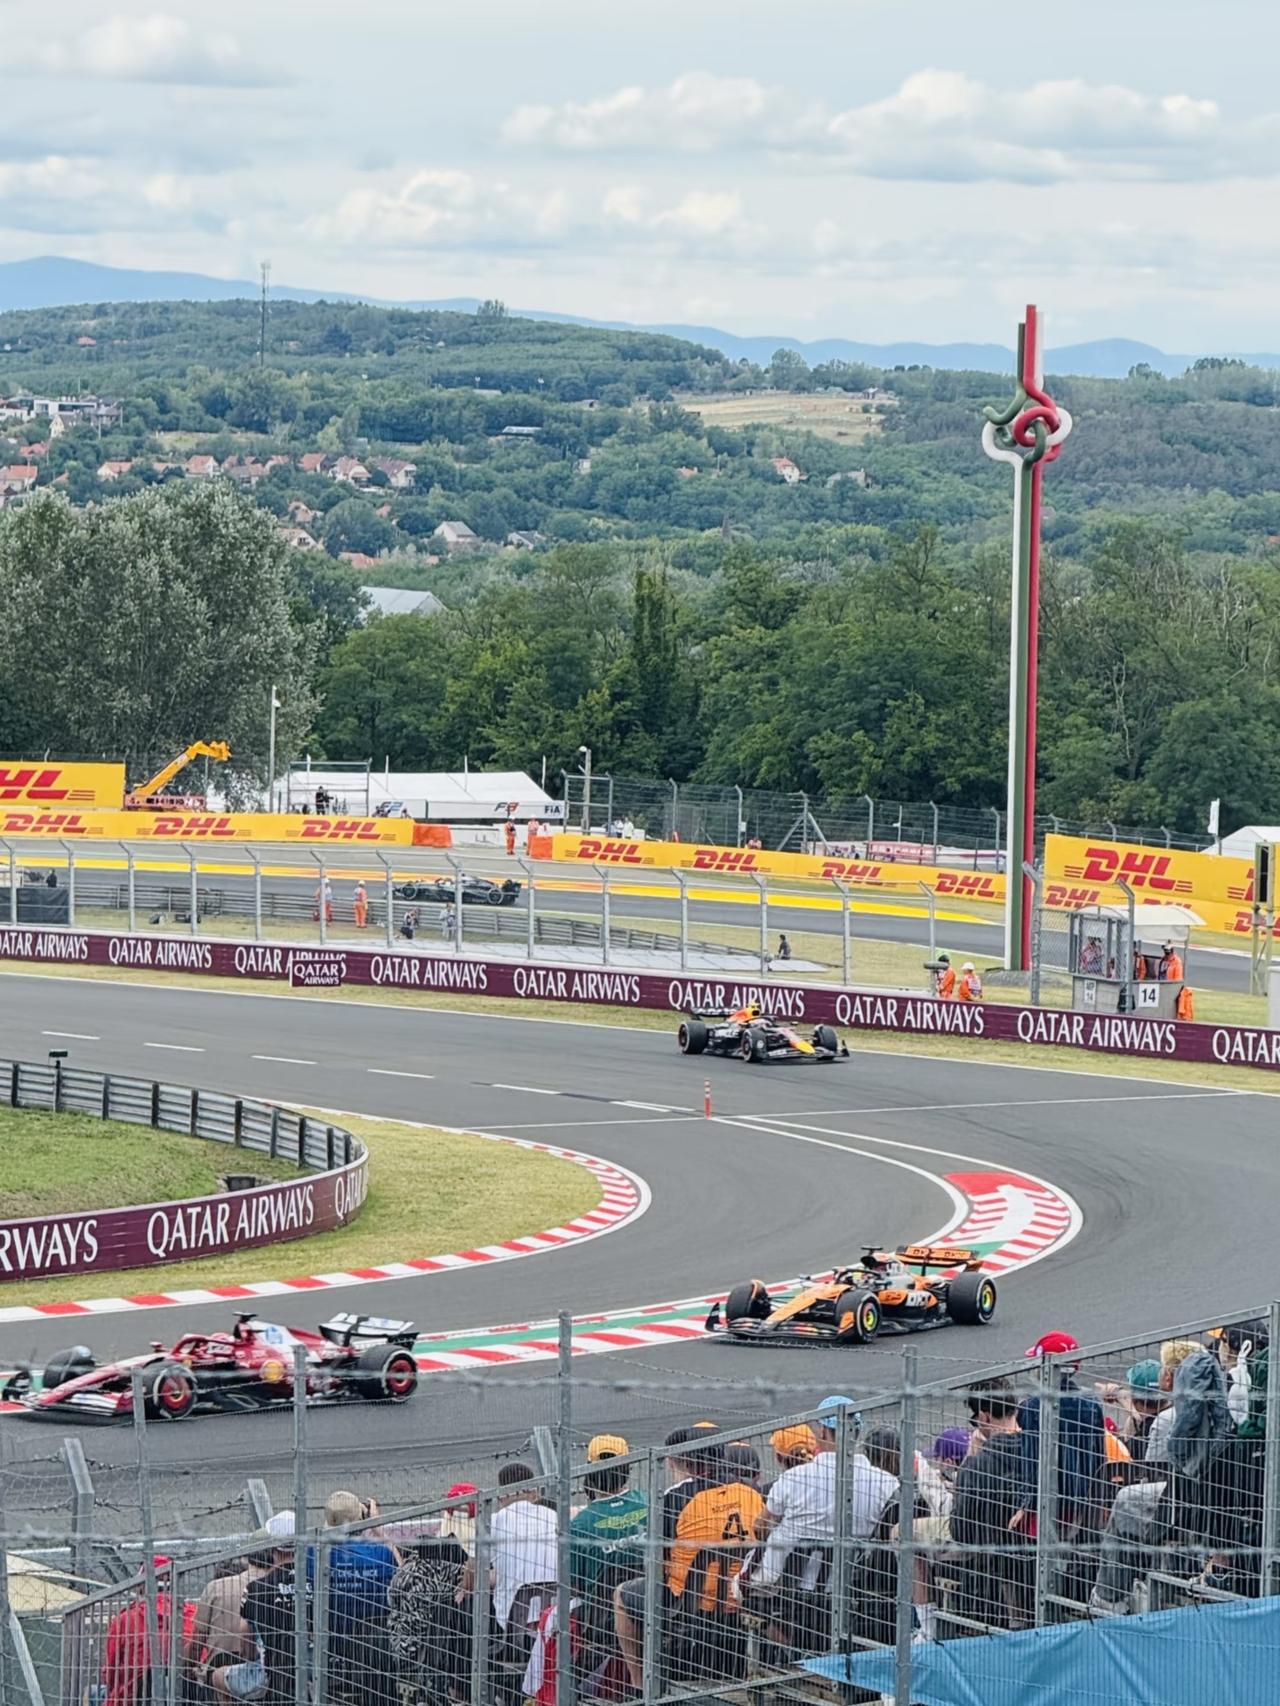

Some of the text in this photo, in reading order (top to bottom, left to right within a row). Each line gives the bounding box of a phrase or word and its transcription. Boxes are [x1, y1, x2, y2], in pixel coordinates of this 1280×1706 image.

[3, 813, 87, 834] DHL
[152, 817, 236, 836] DHL
[301, 819, 381, 840] DHL
[577, 840, 642, 864] DHL
[693, 850, 759, 873] DHL
[821, 862, 884, 886] DHL
[1083, 847, 1176, 890] DHL
[935, 873, 995, 897] DHL
[0, 932, 89, 960] ATAR AIRWAYS
[108, 938, 212, 968] QATAR AIRWAYS
[235, 946, 283, 974] QATAR
[294, 963, 338, 979] QATAR
[371, 956, 421, 985] QATAR
[423, 960, 487, 989] AIRWAYS
[303, 976, 340, 985] AIRWAYS
[513, 968, 640, 1002] QATAR AIRWAYS
[668, 980, 726, 1010] QATAR
[1141, 988, 1156, 1003] 14
[836, 994, 984, 1035] QATAR AIRWAYS
[1017, 1010, 1176, 1054] QATAR AIRWAYS
[147, 1184, 314, 1257] QATAR AIRWAYS
